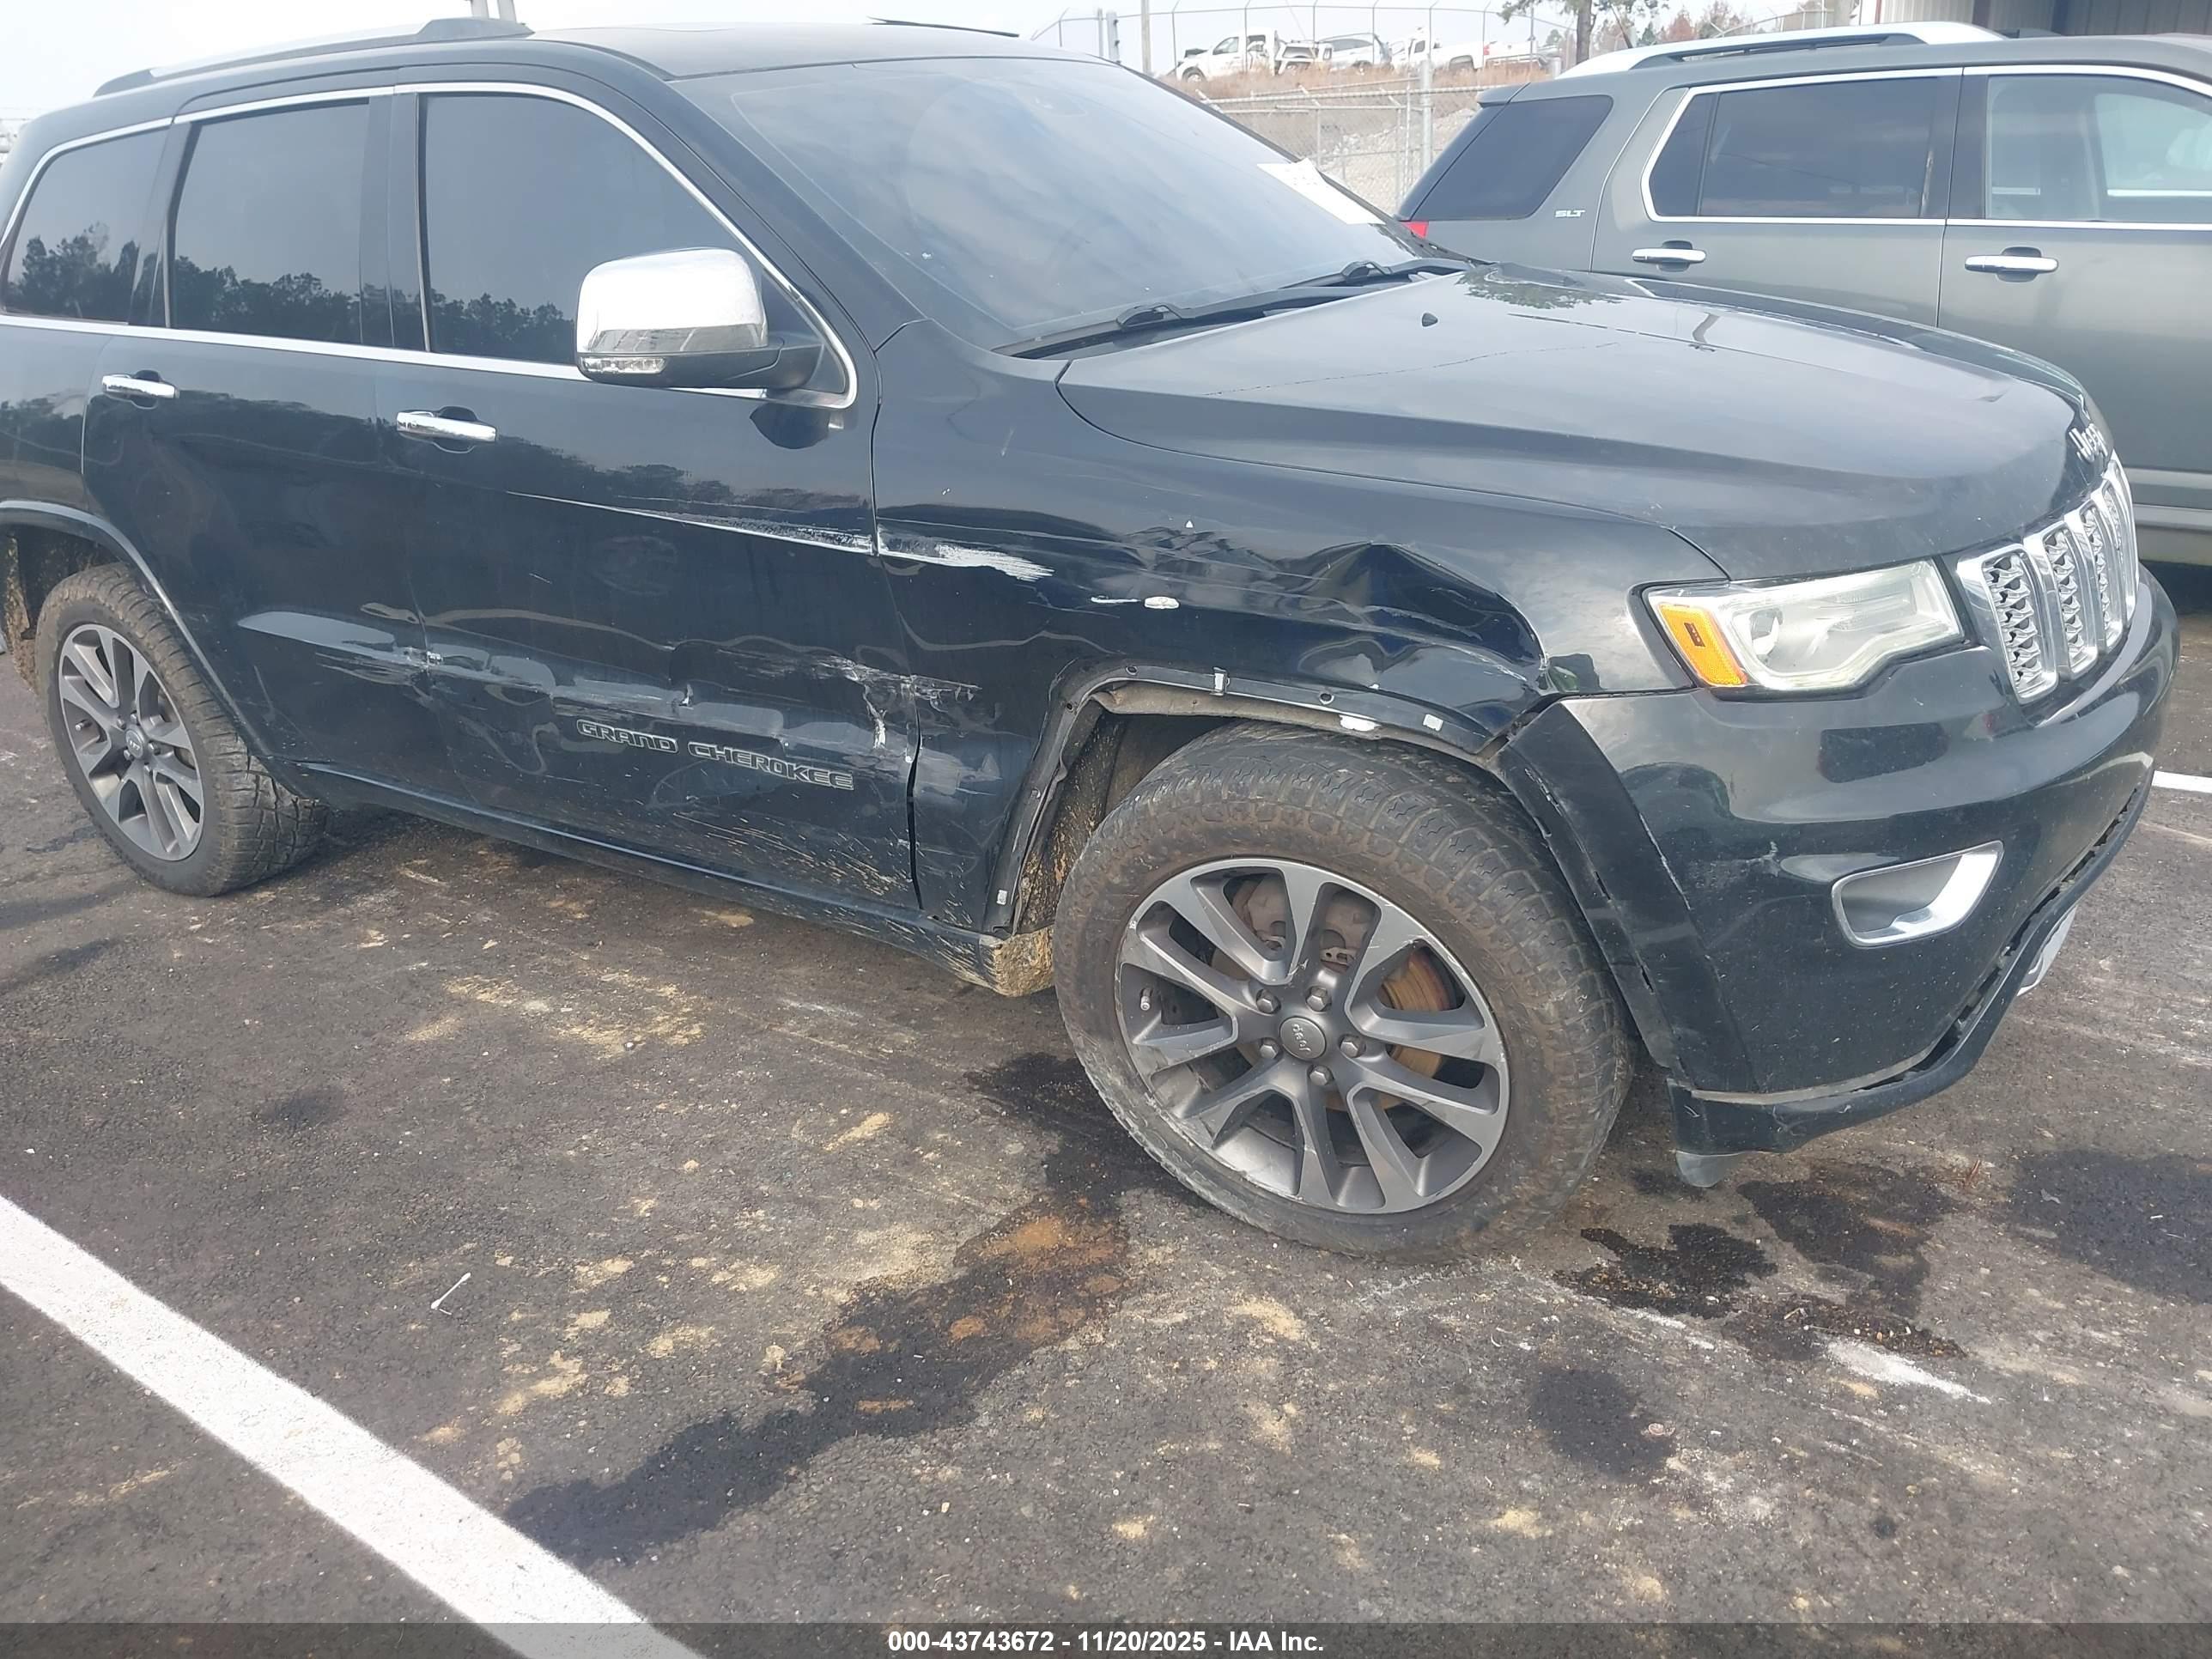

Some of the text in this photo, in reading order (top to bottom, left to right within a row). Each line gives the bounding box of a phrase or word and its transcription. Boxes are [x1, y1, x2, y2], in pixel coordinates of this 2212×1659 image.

[1555, 210, 1586, 218] SLT
[576, 719, 855, 791] GRAND CHEROKEE
